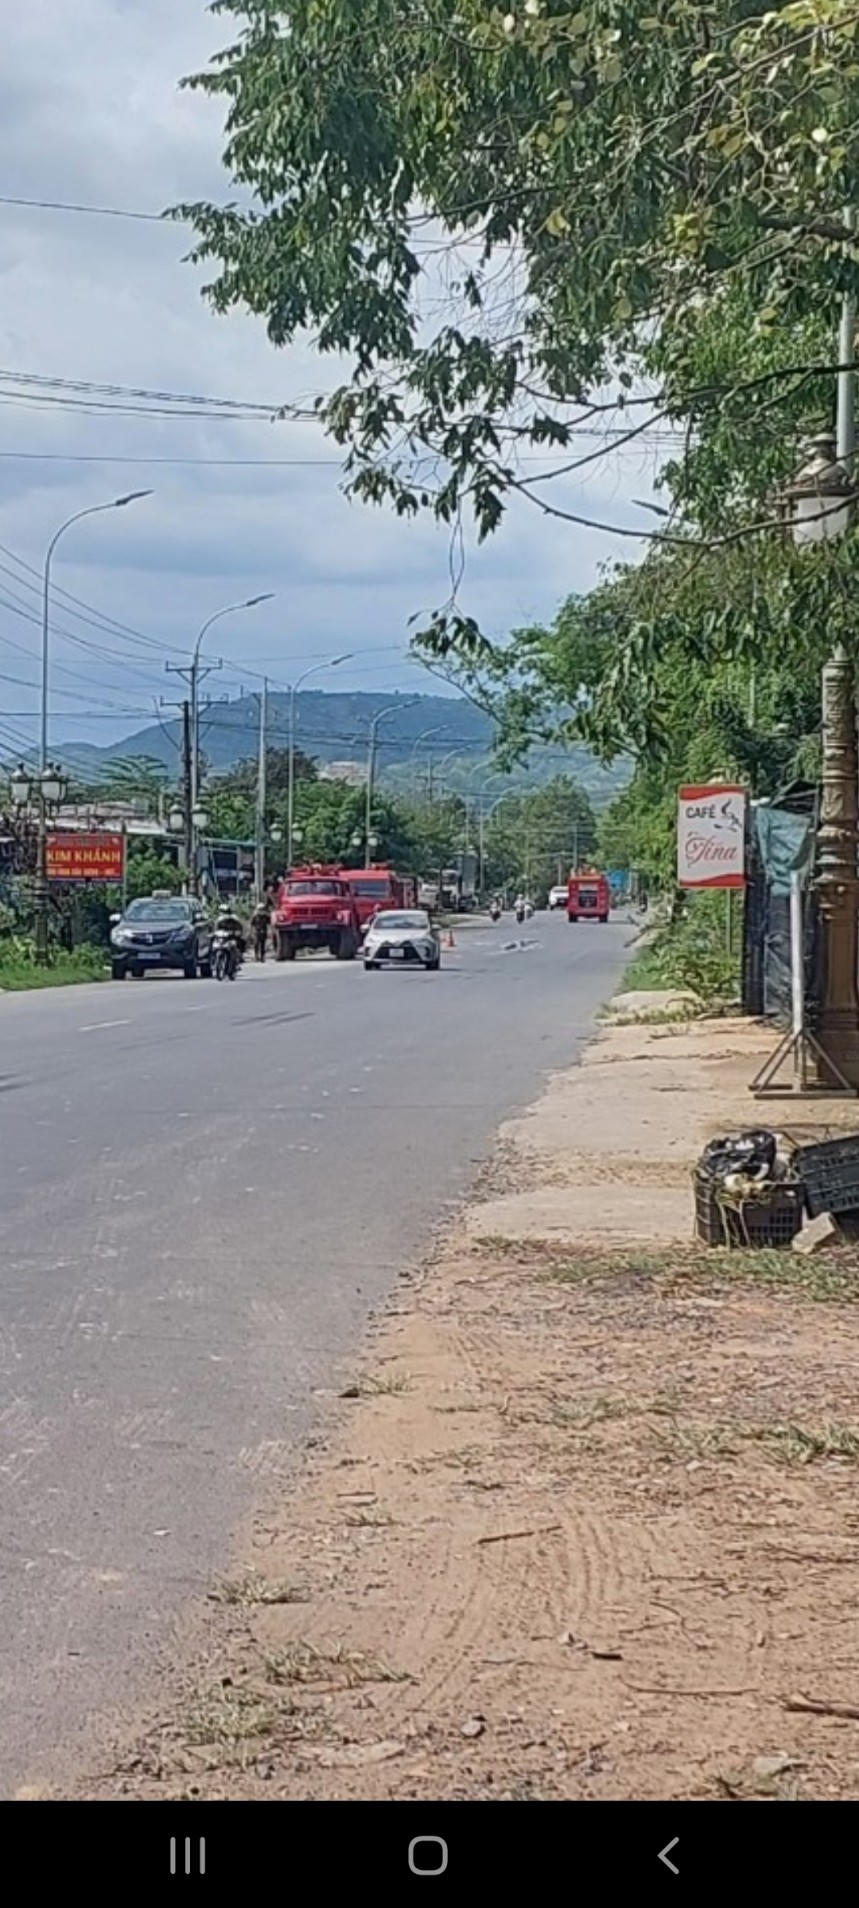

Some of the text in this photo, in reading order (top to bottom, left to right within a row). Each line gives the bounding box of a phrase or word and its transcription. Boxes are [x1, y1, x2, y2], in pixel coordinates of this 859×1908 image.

[685, 804, 716, 818] CAFÉ
[47, 847, 121, 862] KIM KHÁNH
